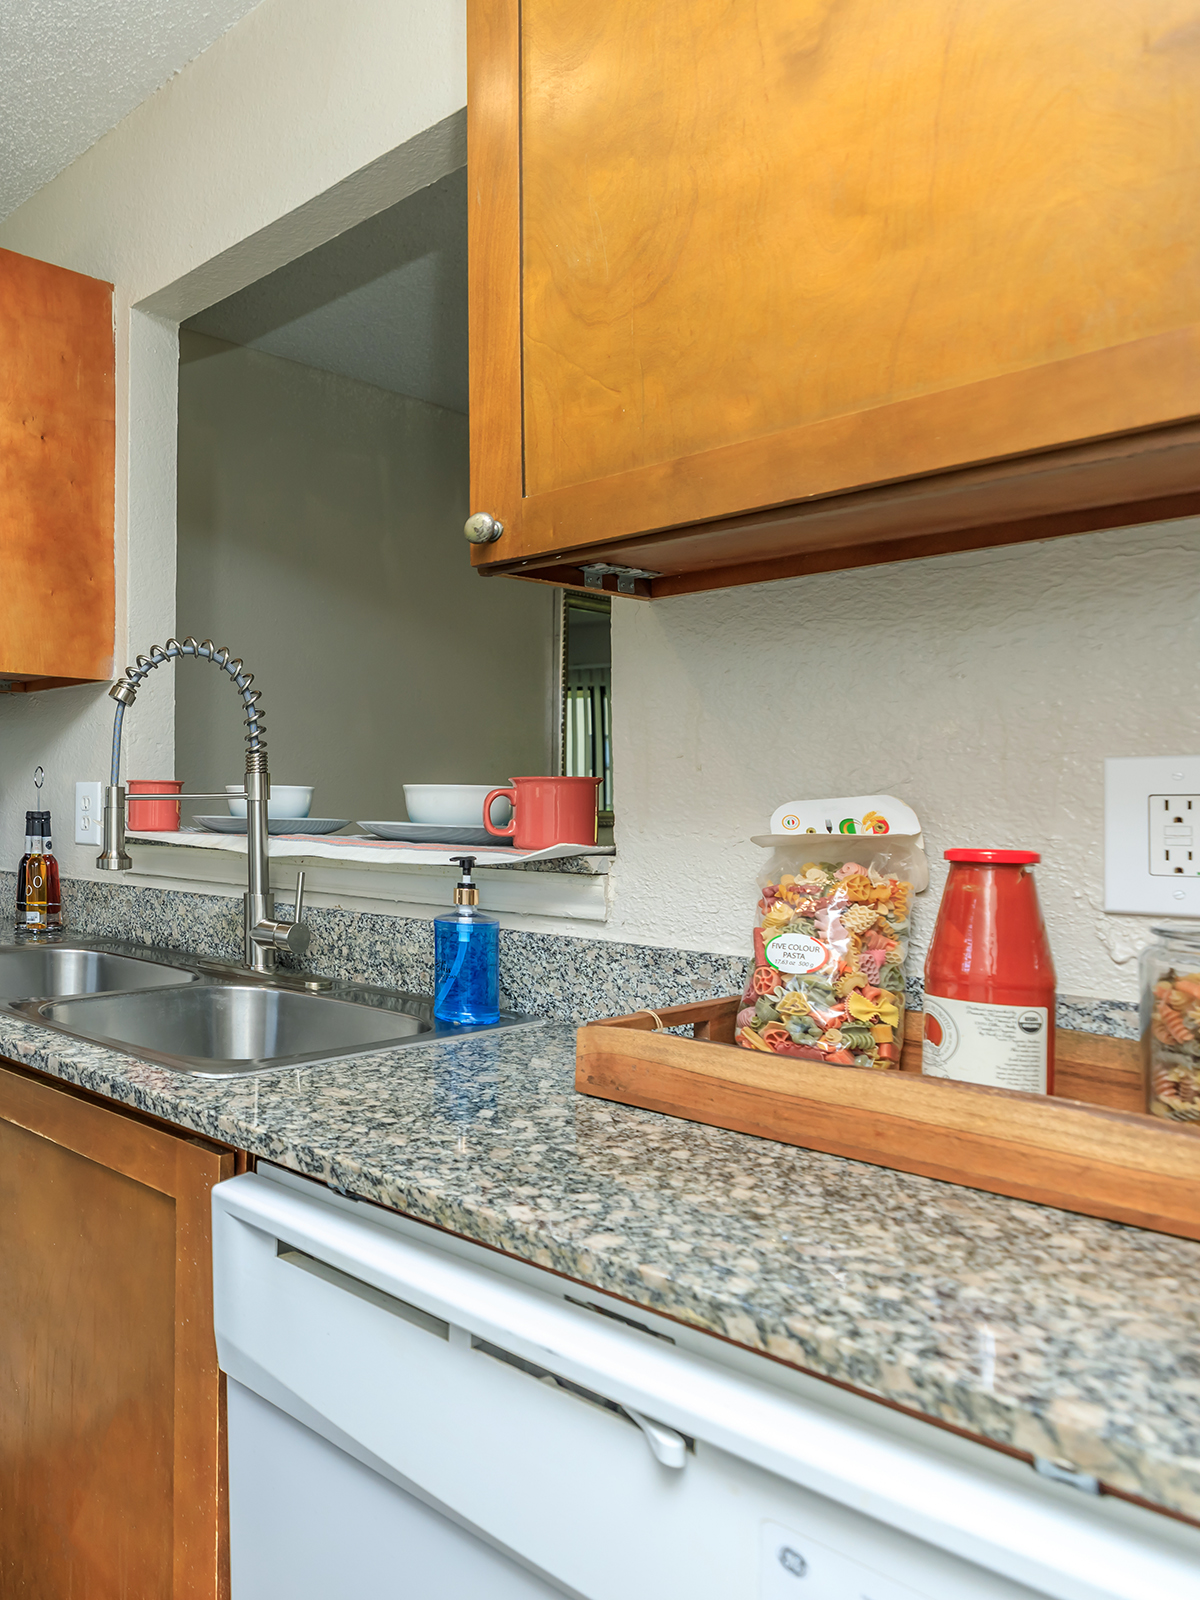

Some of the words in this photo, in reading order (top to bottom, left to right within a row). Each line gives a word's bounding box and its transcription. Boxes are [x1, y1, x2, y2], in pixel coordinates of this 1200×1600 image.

[771, 942, 786, 950] FIVE
[787, 944, 820, 953] COLOUR
[782, 952, 805, 960] PASTA
